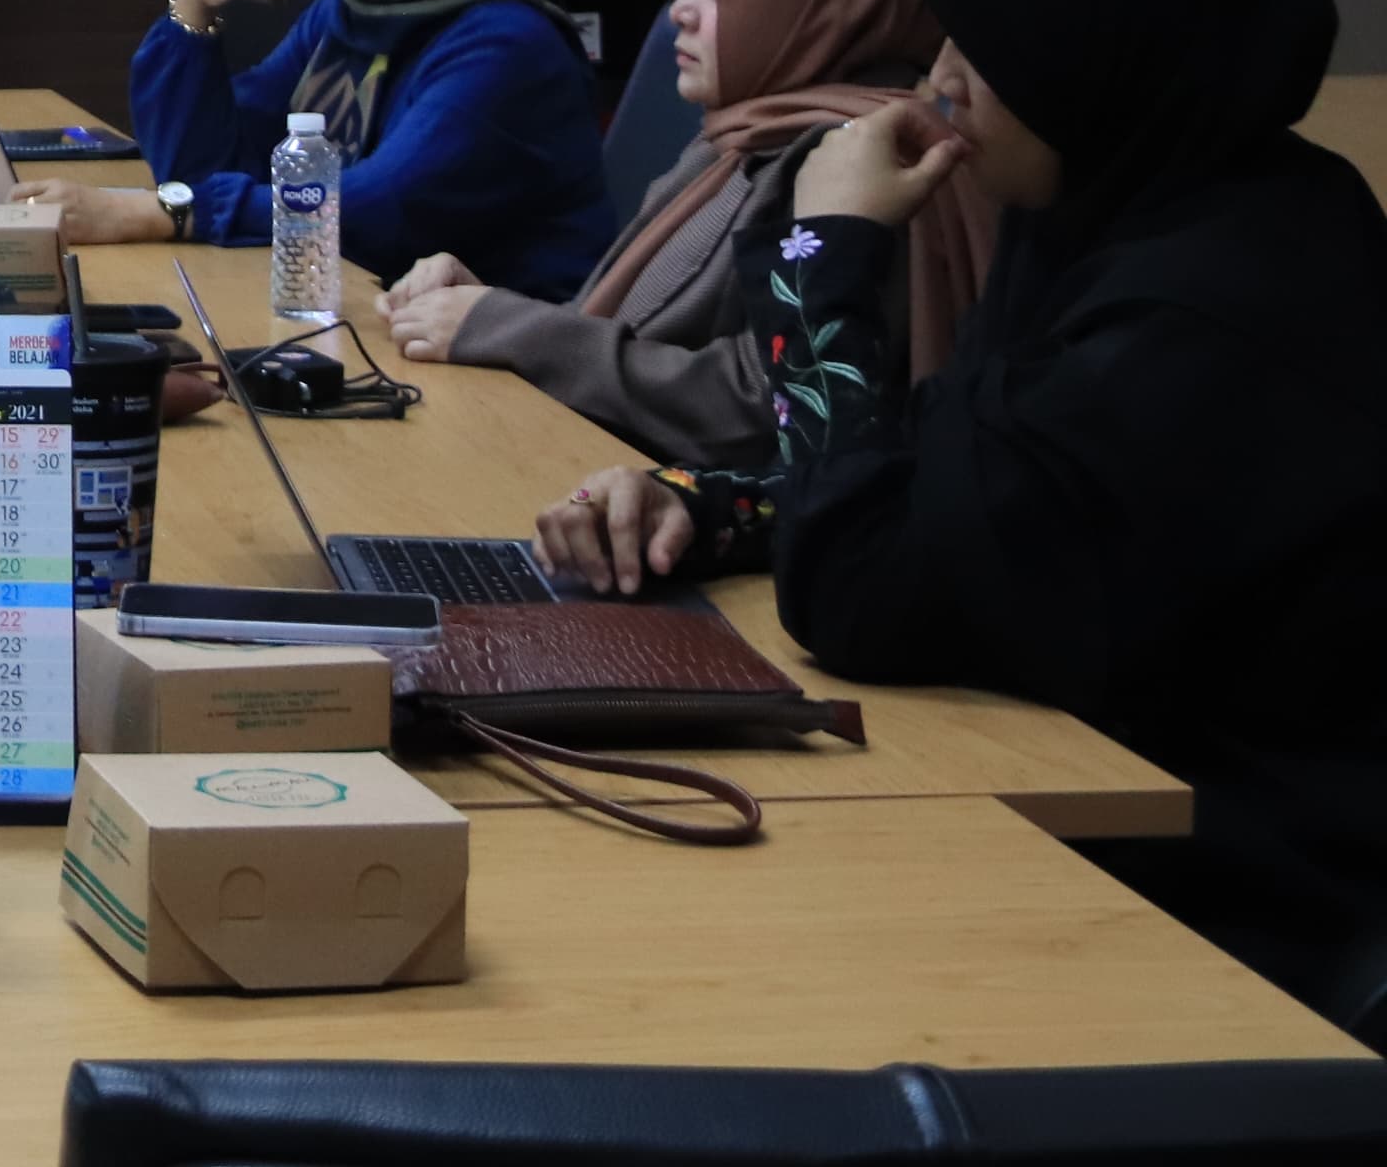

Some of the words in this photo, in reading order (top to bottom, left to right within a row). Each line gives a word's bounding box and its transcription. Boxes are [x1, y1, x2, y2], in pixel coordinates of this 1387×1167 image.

[10, 350, 60, 364] BELAJAR
[0, 427, 19, 443] 15
[37, 427, 60, 443] 29
[1, 454, 19, 469] 16
[37, 453, 60, 469] 30
[0, 479, 19, 495] 17
[1, 505, 19, 521] 18
[2, 532, 19, 547] 19
[0, 558, 21, 574] 20
[1, 584, 20, 601] 21
[0, 611, 21, 627] 22
[0, 637, 21, 653] 23
[0, 663, 22, 680] 24
[0, 690, 23, 707] 25
[0, 716, 22, 732] 26
[0, 743, 22, 759] 27
[0, 769, 23, 786] 28
